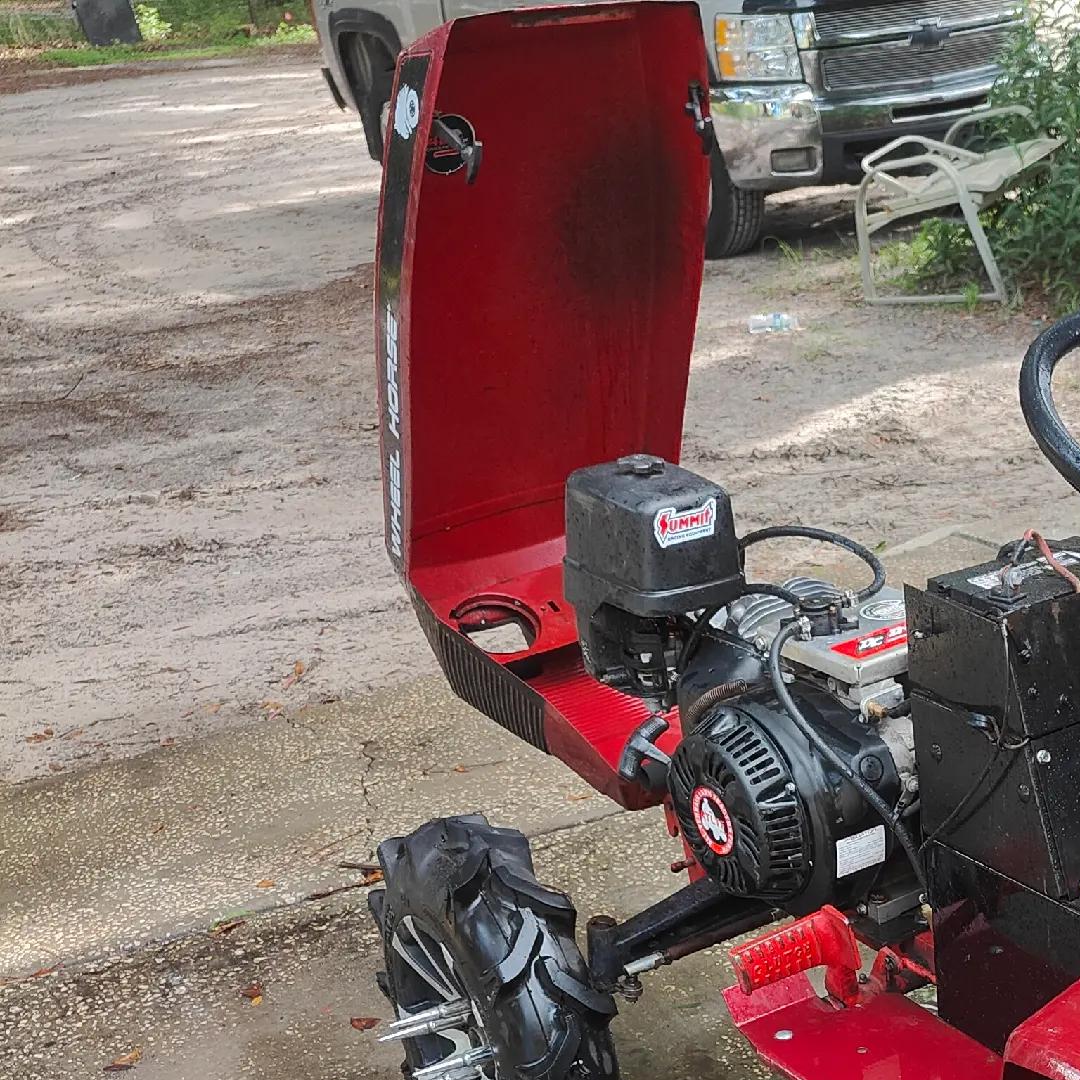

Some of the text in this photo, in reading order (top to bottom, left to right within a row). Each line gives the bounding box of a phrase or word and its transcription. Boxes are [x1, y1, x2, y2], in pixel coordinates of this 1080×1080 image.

[386, 305, 403, 557] WHEEL HORSE
[658, 505, 712, 538] SUMMIT
